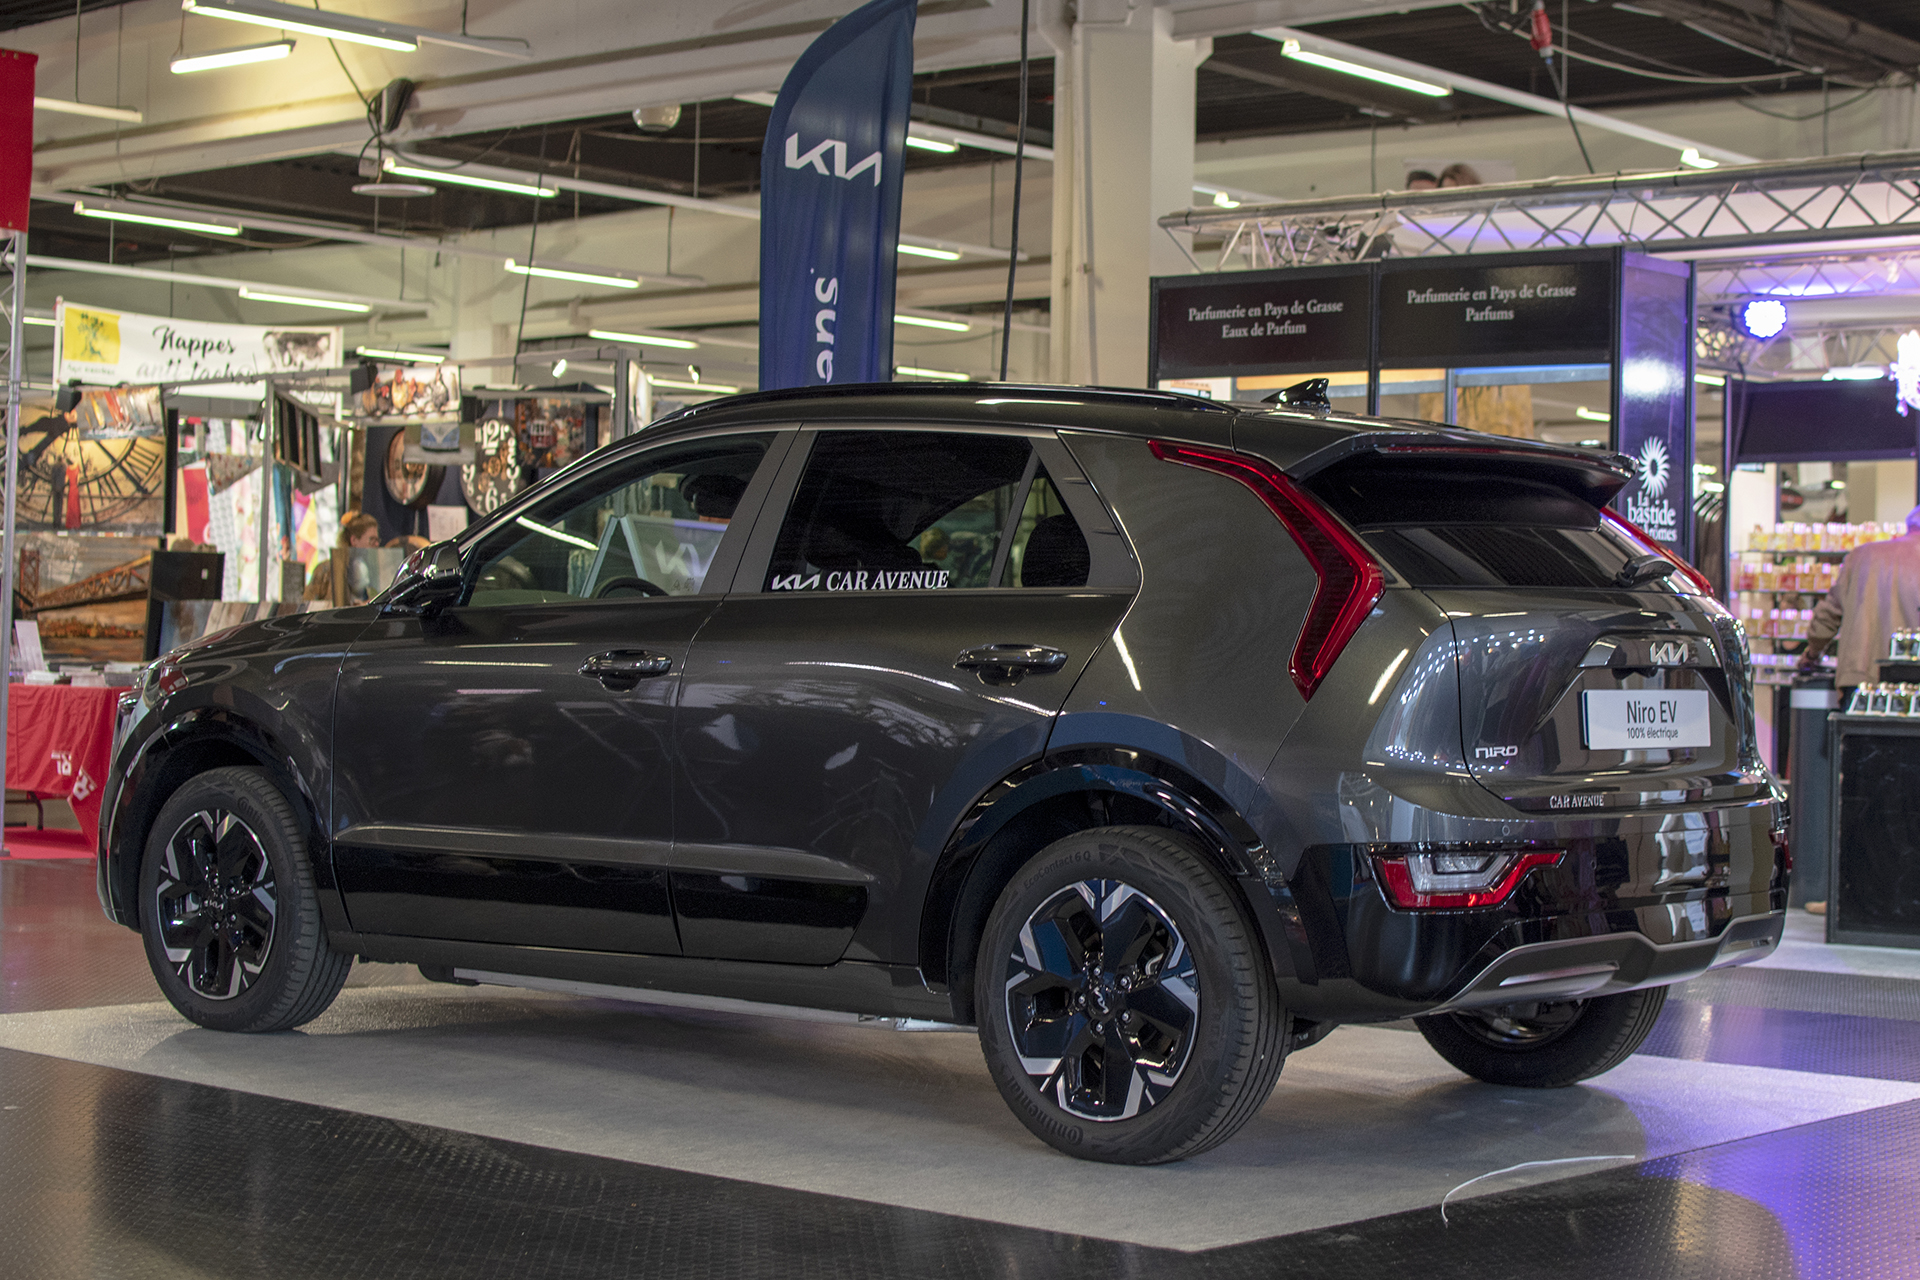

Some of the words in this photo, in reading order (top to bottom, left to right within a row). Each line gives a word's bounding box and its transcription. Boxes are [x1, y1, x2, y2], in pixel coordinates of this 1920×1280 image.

[785, 133, 882, 187] KIA
[1407, 287, 1470, 304] Parfumerie
[1472, 290, 1487, 301] en
[1489, 285, 1517, 303] Pays
[1519, 284, 1534, 299] de
[1536, 283, 1577, 298] Grasse
[1188, 304, 1246, 321] Parfumerie
[1248, 306, 1262, 317] en
[1264, 302, 1289, 320] Pays
[1290, 300, 1305, 315] de
[1306, 299, 1343, 314] Grasse
[1465, 305, 1515, 322] Parfums
[1222, 324, 1249, 339] Eaux
[1250, 322, 1264, 337] de
[1266, 319, 1307, 336] Parfum
[152, 323, 237, 359] Nappes
[482, 420, 500, 450] 12
[484, 486, 498, 514] 6
[1637, 490, 1650, 507] La
[1627, 496, 1676, 526] bastide
[771, 574, 821, 590] KIA
[826, 570, 869, 591] CAR
[871, 569, 950, 590] AVENUE
[1650, 641, 1689, 664] KIA
[1626, 700, 1656, 724] Niro
[1659, 700, 1678, 723] EV
[1626, 728, 1645, 740] 100%
[1646, 727, 1679, 741] électrique
[1549, 796, 1570, 809] CAR
[1571, 794, 1605, 808] AVENUE
[1023, 854, 1073, 891] EcoContact
